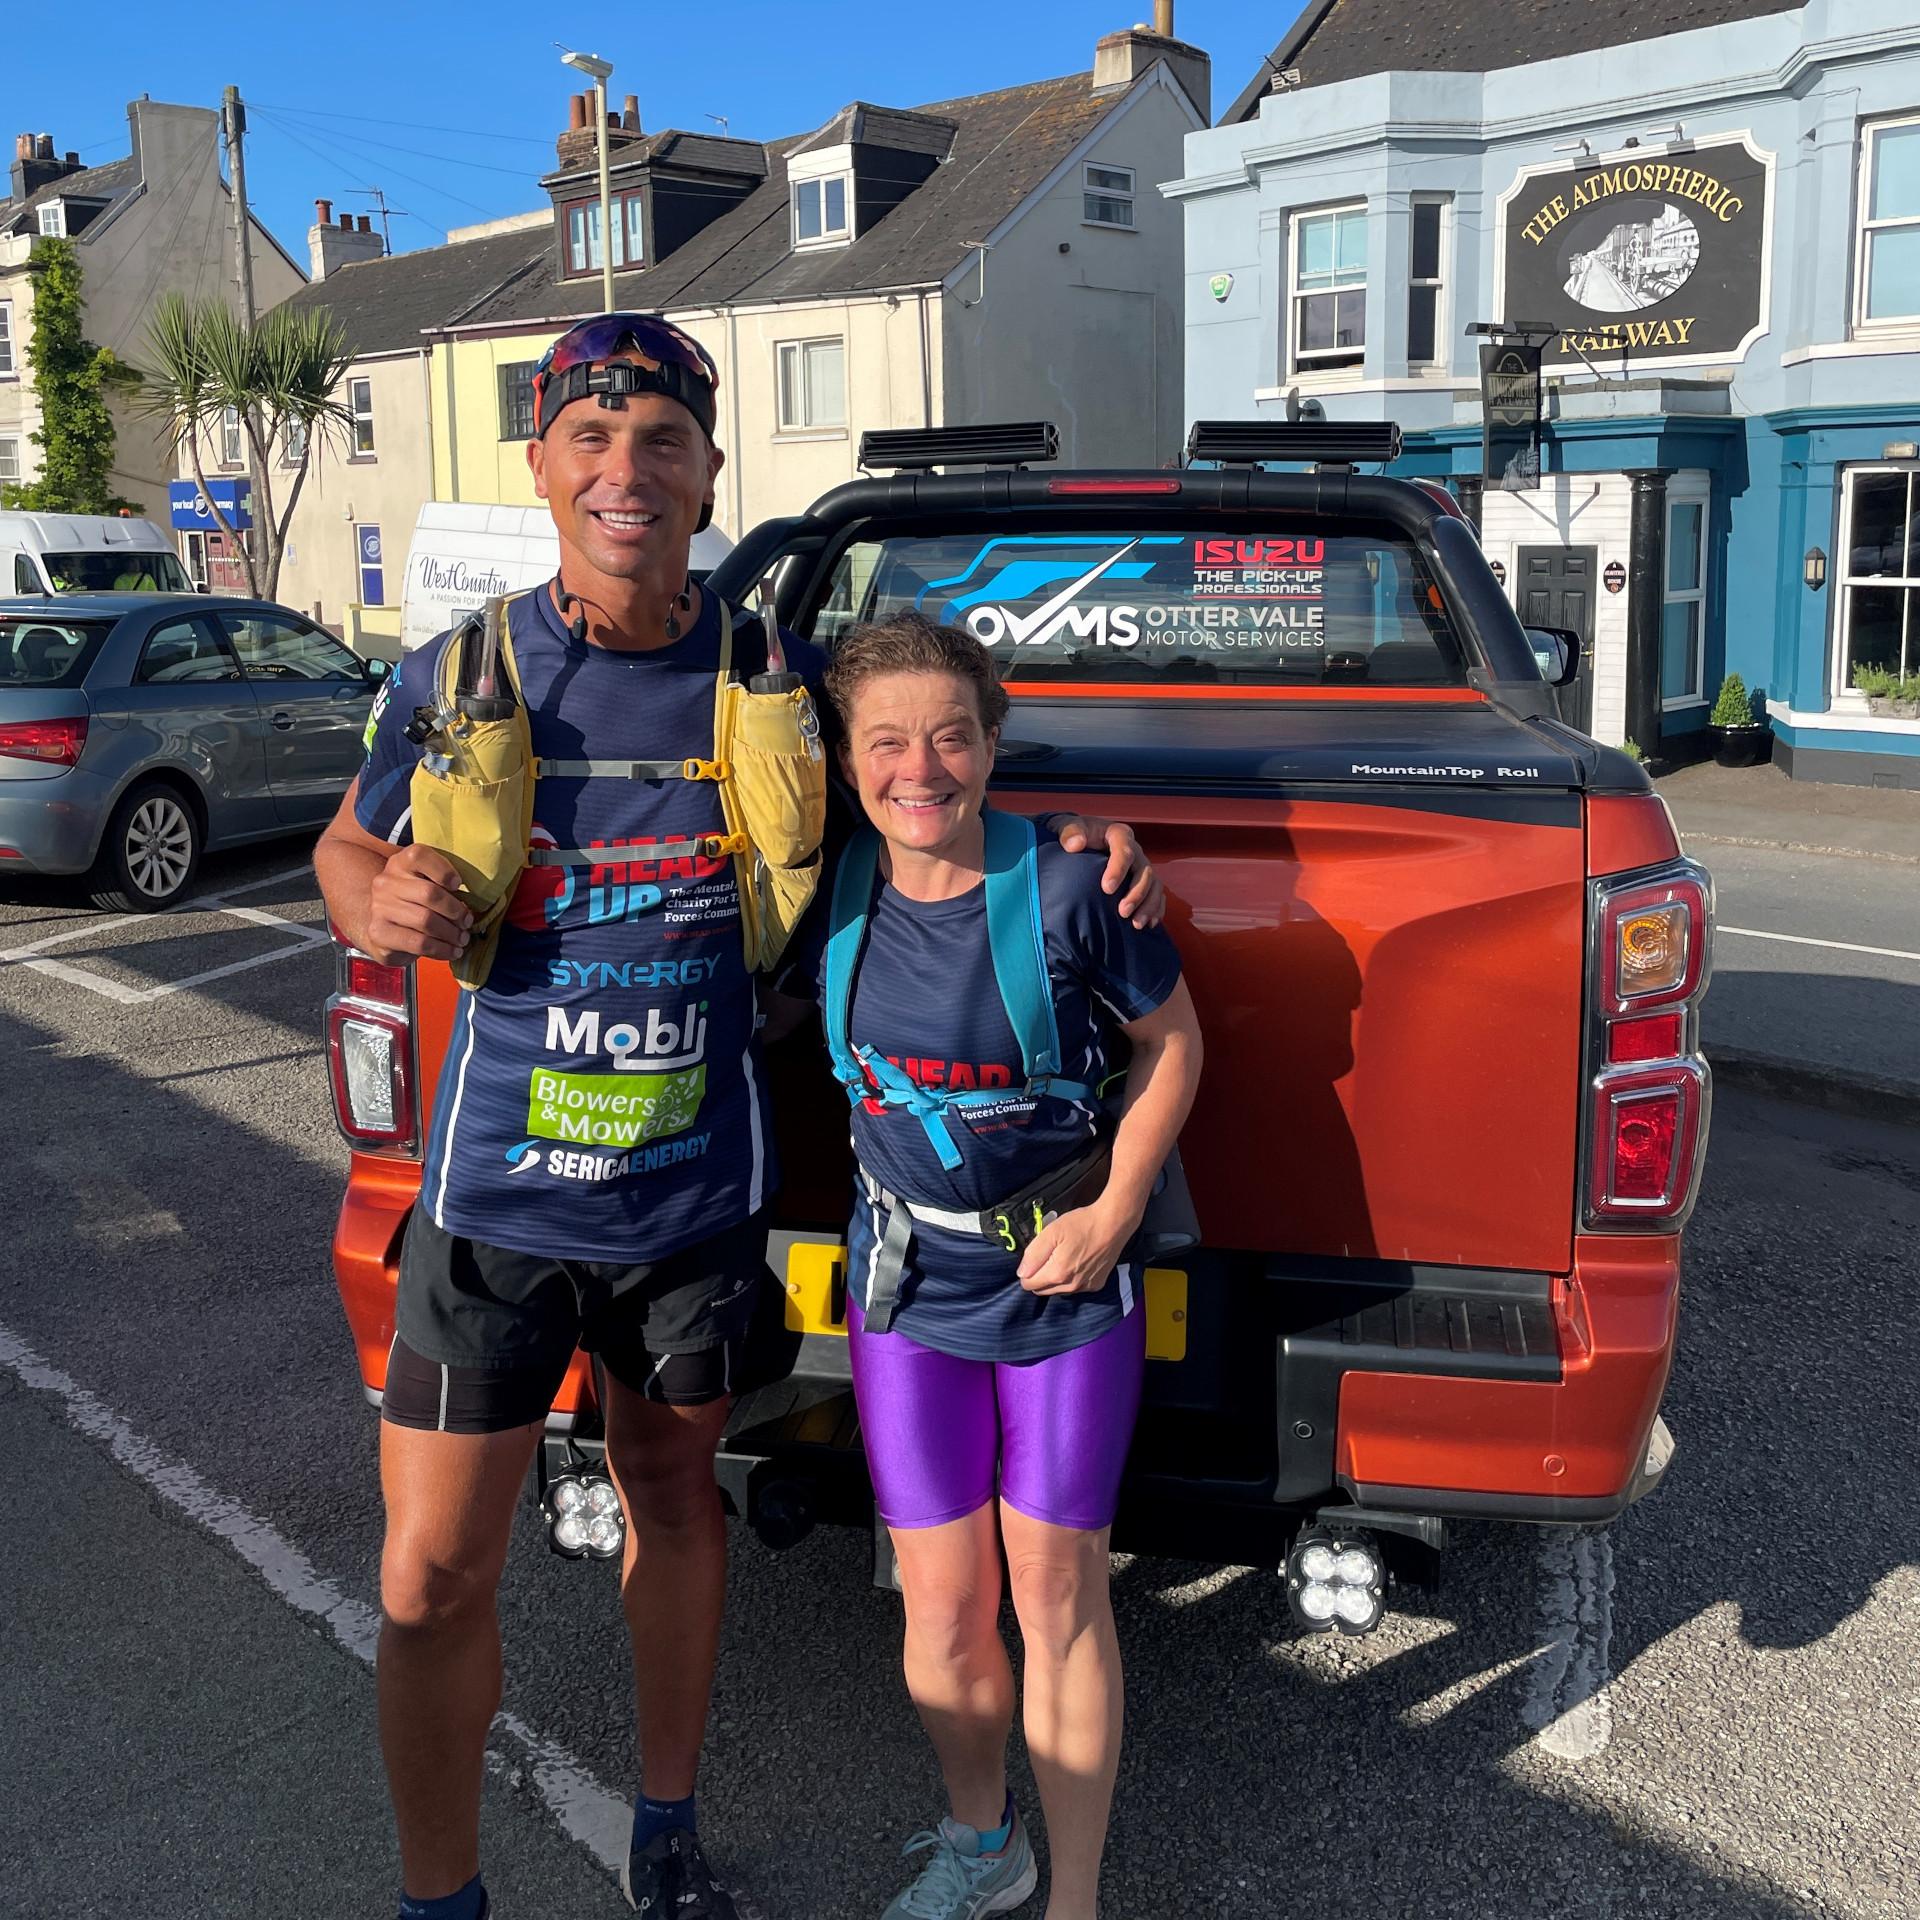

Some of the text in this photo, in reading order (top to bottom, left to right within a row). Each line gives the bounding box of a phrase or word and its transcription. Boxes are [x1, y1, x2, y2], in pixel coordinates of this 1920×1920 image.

[1522, 164, 1744, 246] THE ATMOSPHERIC
[1560, 318, 1696, 353] RAILWAY
[1194, 540, 1325, 563] ISUZU
[1194, 570, 1323, 582] THE PICK-UP
[1193, 584, 1323, 594] PROFESSIONALS
[1145, 606, 1324, 628] OTTER VALE
[1146, 631, 1325, 647] MOTOR SERVICES
[1351, 764, 1539, 779] MountainTop Roll
[589, 832, 728, 885] HEAD
[669, 880, 735, 897] The Mental
[588, 884, 662, 924] UP
[666, 897, 713, 909] Charity
[713, 896, 729, 905] For
[664, 906, 740, 923] Forces Commu
[548, 953, 722, 988] SYNERGY
[537, 1076, 656, 1117] Blowers
[961, 1107, 995, 1120] Forces
